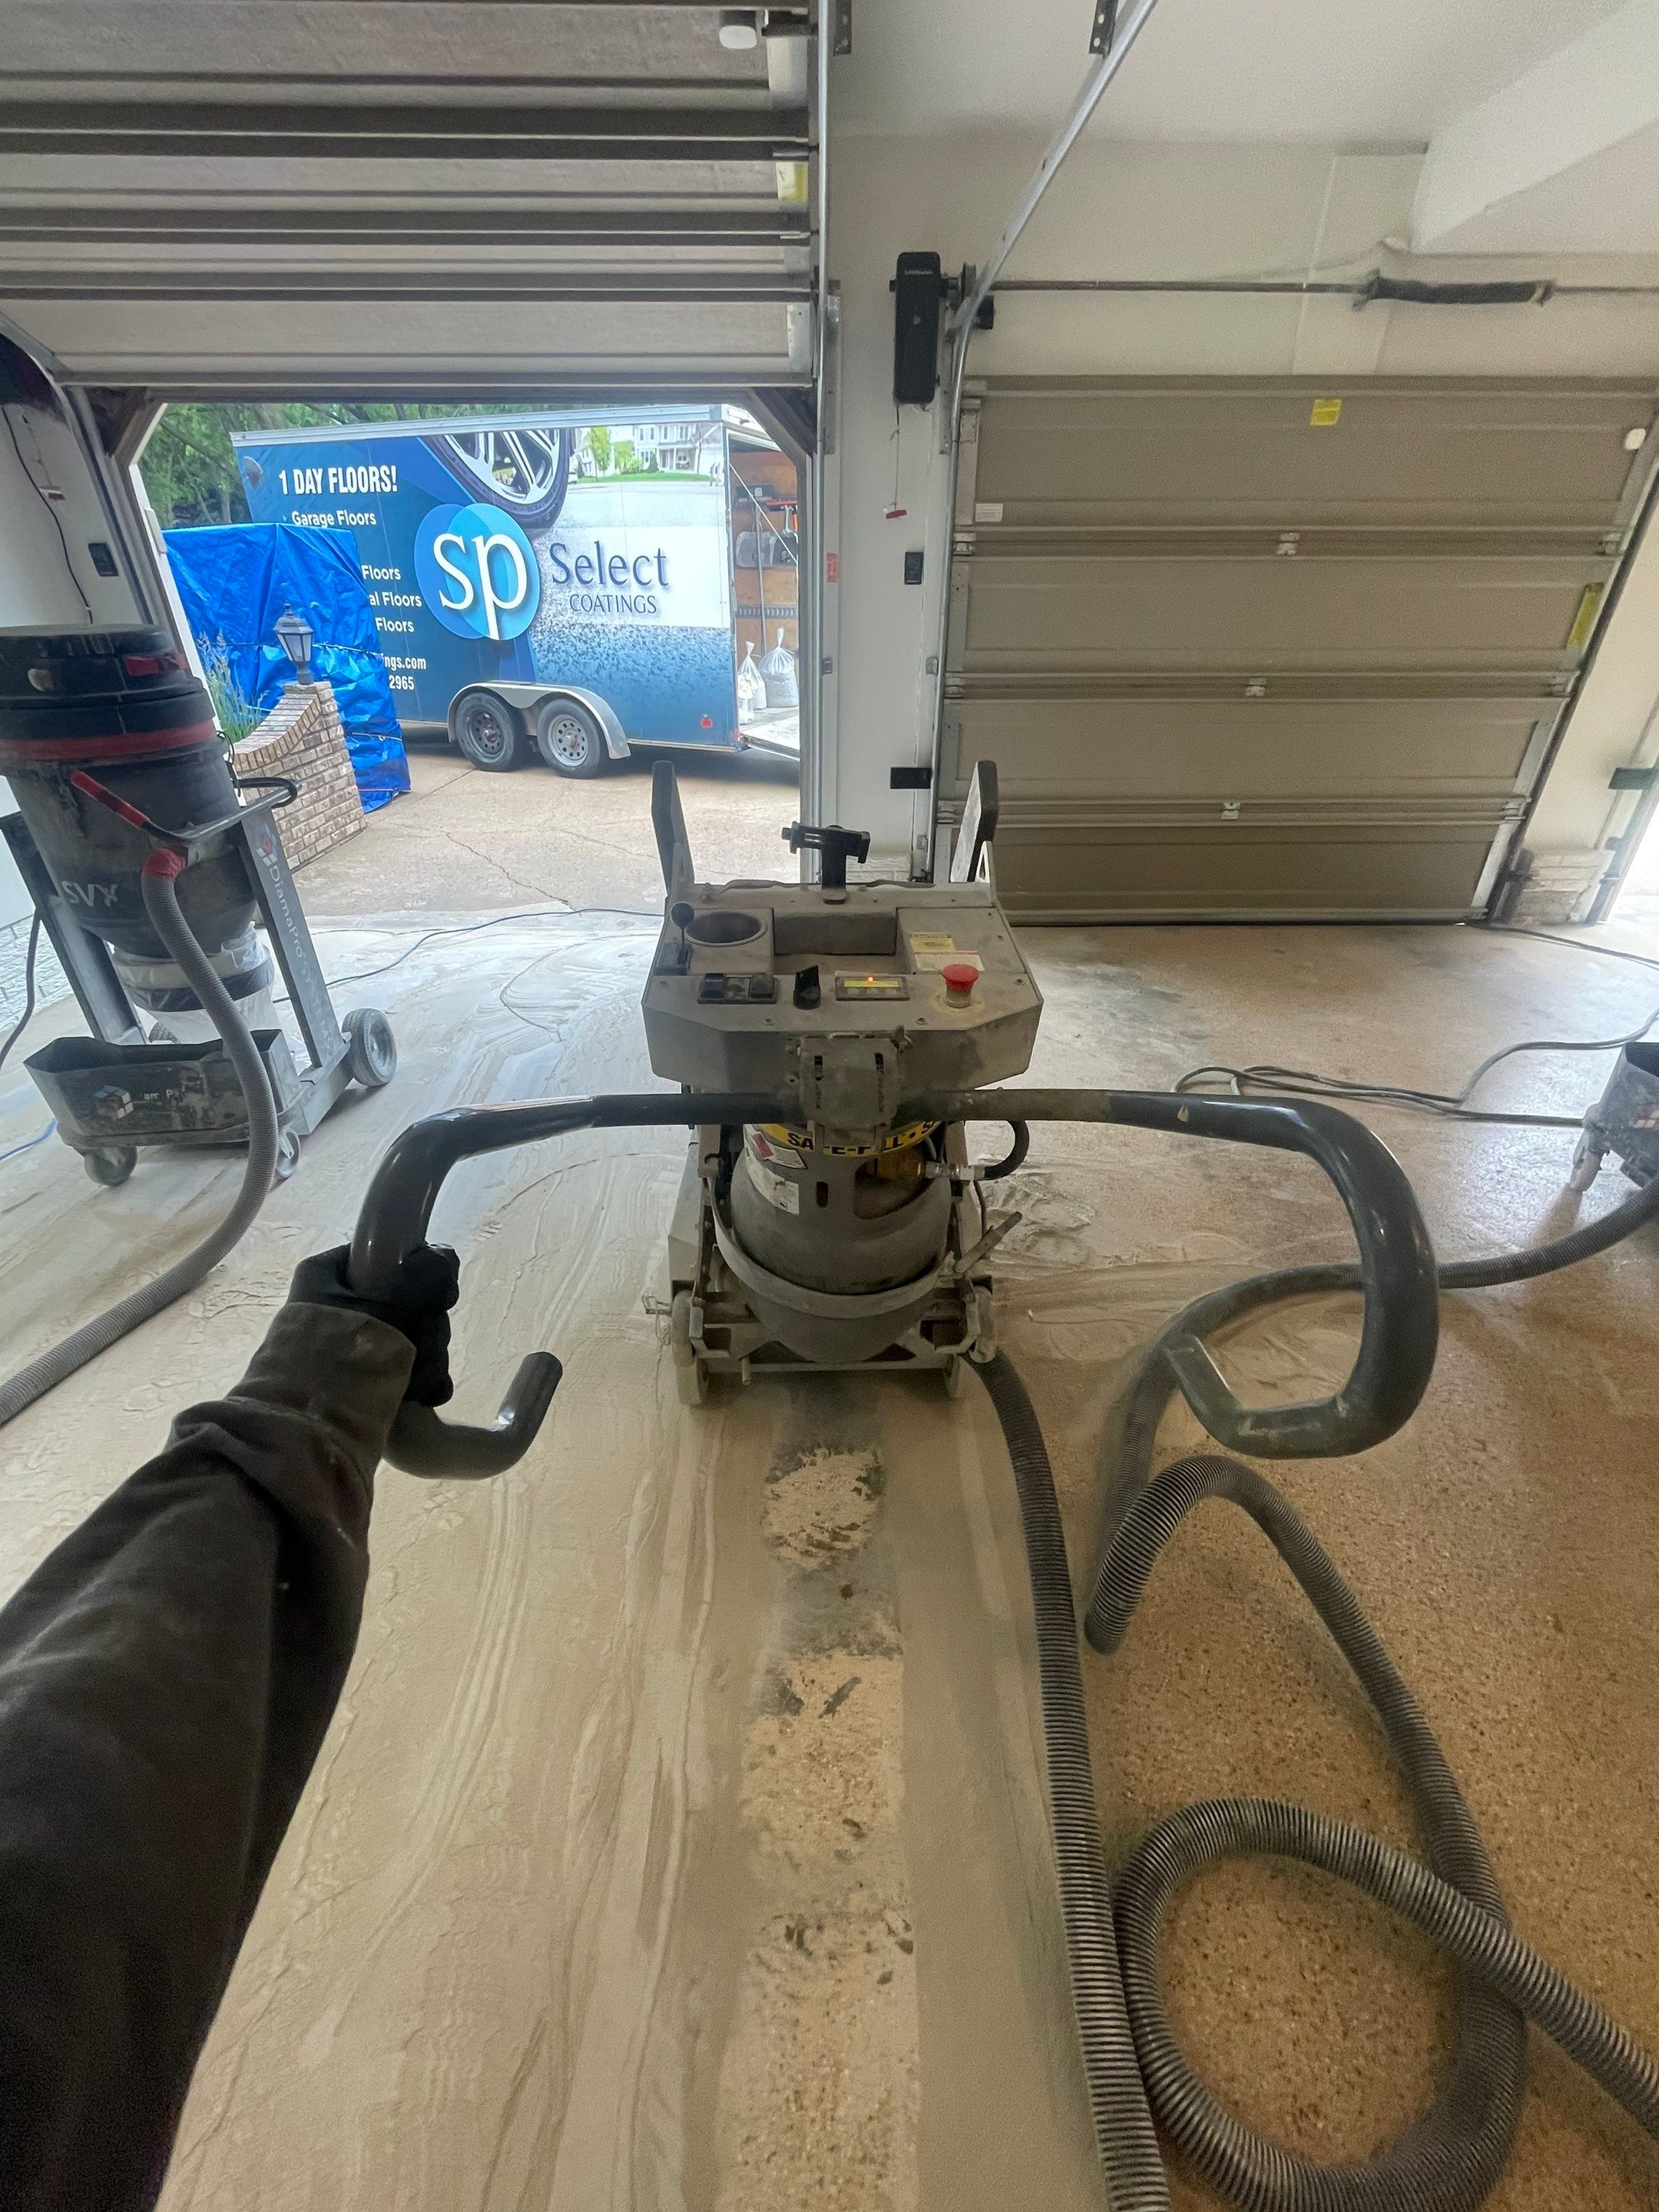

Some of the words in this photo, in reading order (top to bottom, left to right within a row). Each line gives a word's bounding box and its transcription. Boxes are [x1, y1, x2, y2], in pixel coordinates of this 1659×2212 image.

[279, 469, 289, 495] 1
[293, 468, 323, 495] DAY
[328, 465, 398, 494] FLOORS!
[291, 510, 335, 528] Garage
[336, 509, 377, 526] Floors
[361, 565, 402, 581] Floors
[549, 540, 669, 587] Select
[432, 533, 528, 641] sp
[382, 591, 422, 608] Floors
[569, 594, 657, 614] COATINGS
[375, 617, 415, 633] Floors
[389, 675, 415, 690] 2965
[61, 880, 119, 907] SVX
[269, 866, 303, 959] DiamaPro
